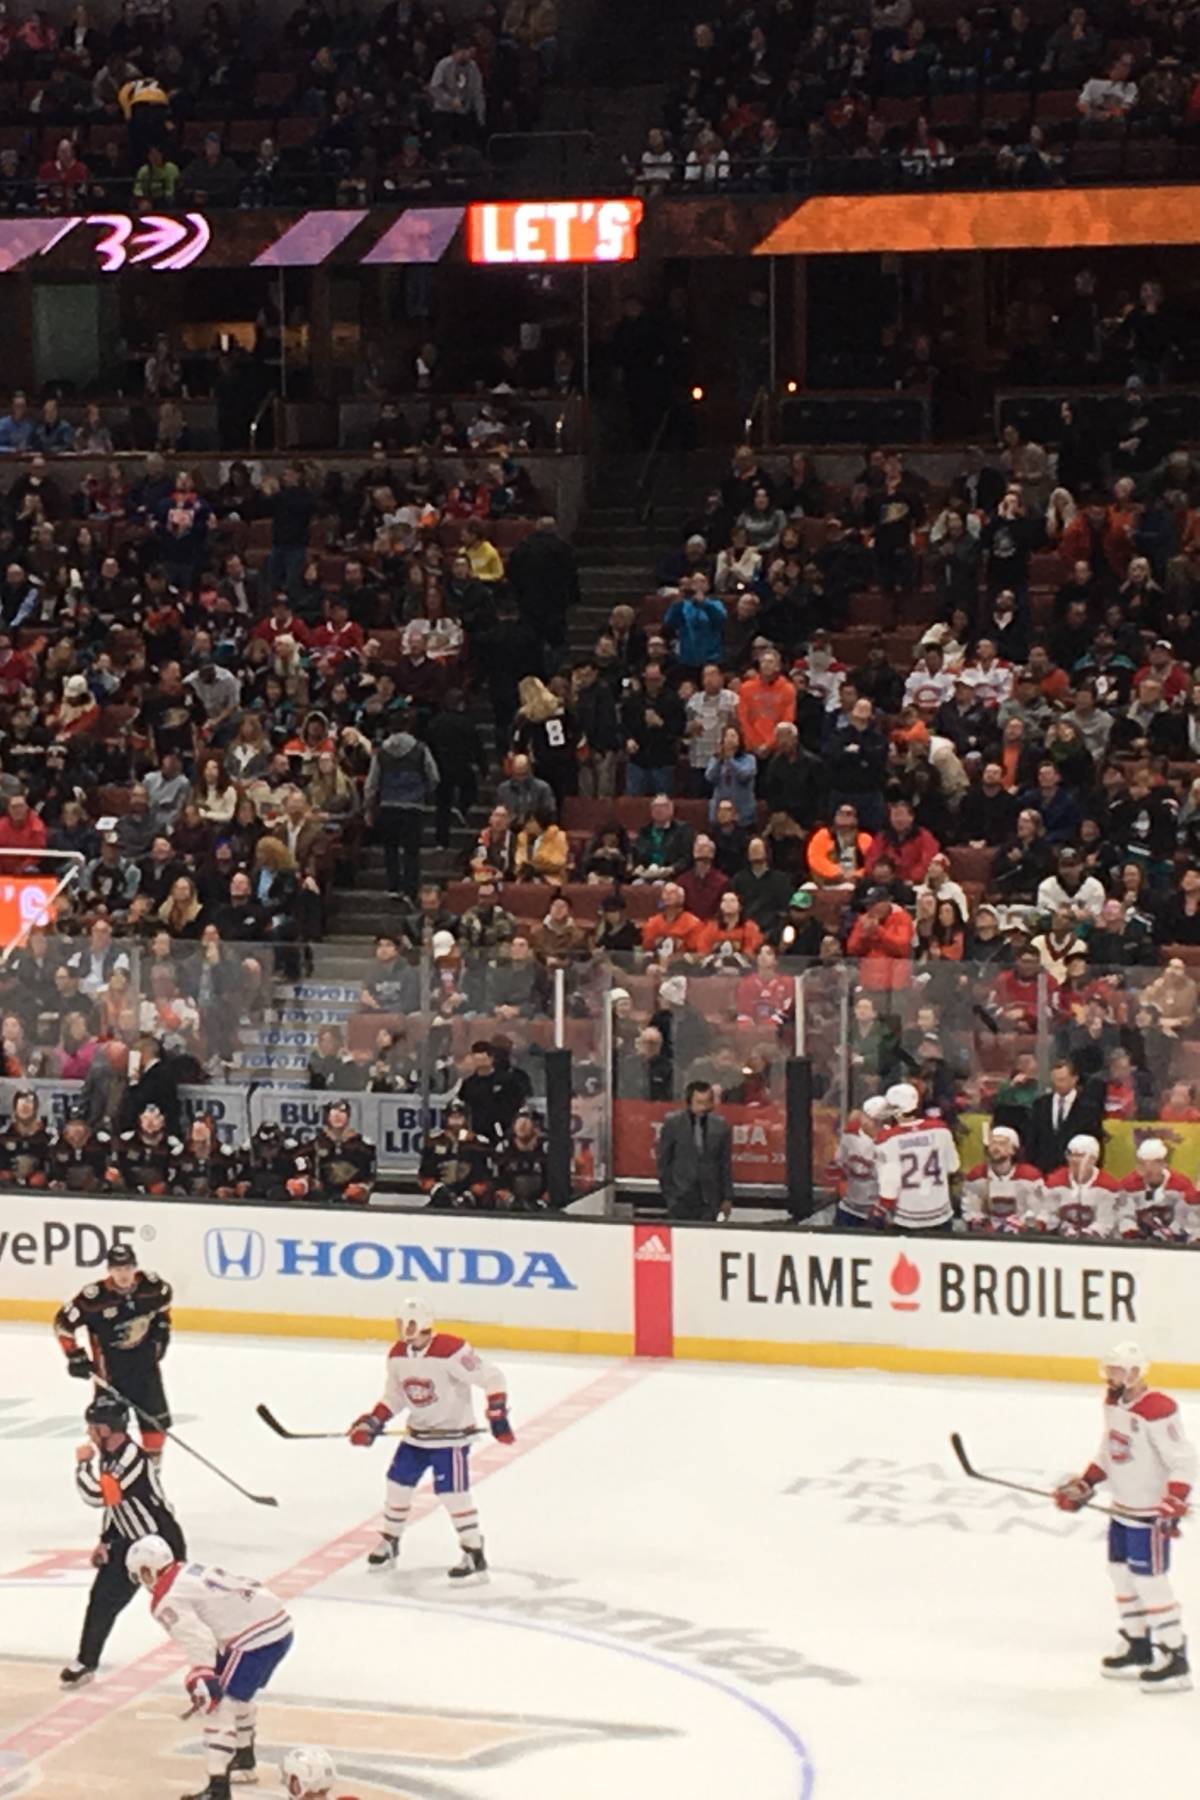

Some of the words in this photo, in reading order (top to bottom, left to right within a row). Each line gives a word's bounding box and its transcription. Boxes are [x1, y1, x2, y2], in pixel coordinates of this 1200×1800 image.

[482, 200, 632, 263] LET'S
[899, 1149, 944, 1189] 24
[276, 1238, 578, 1291] HONDA
[720, 1251, 873, 1308] FLAME
[940, 1262, 1138, 1322] BROILER
